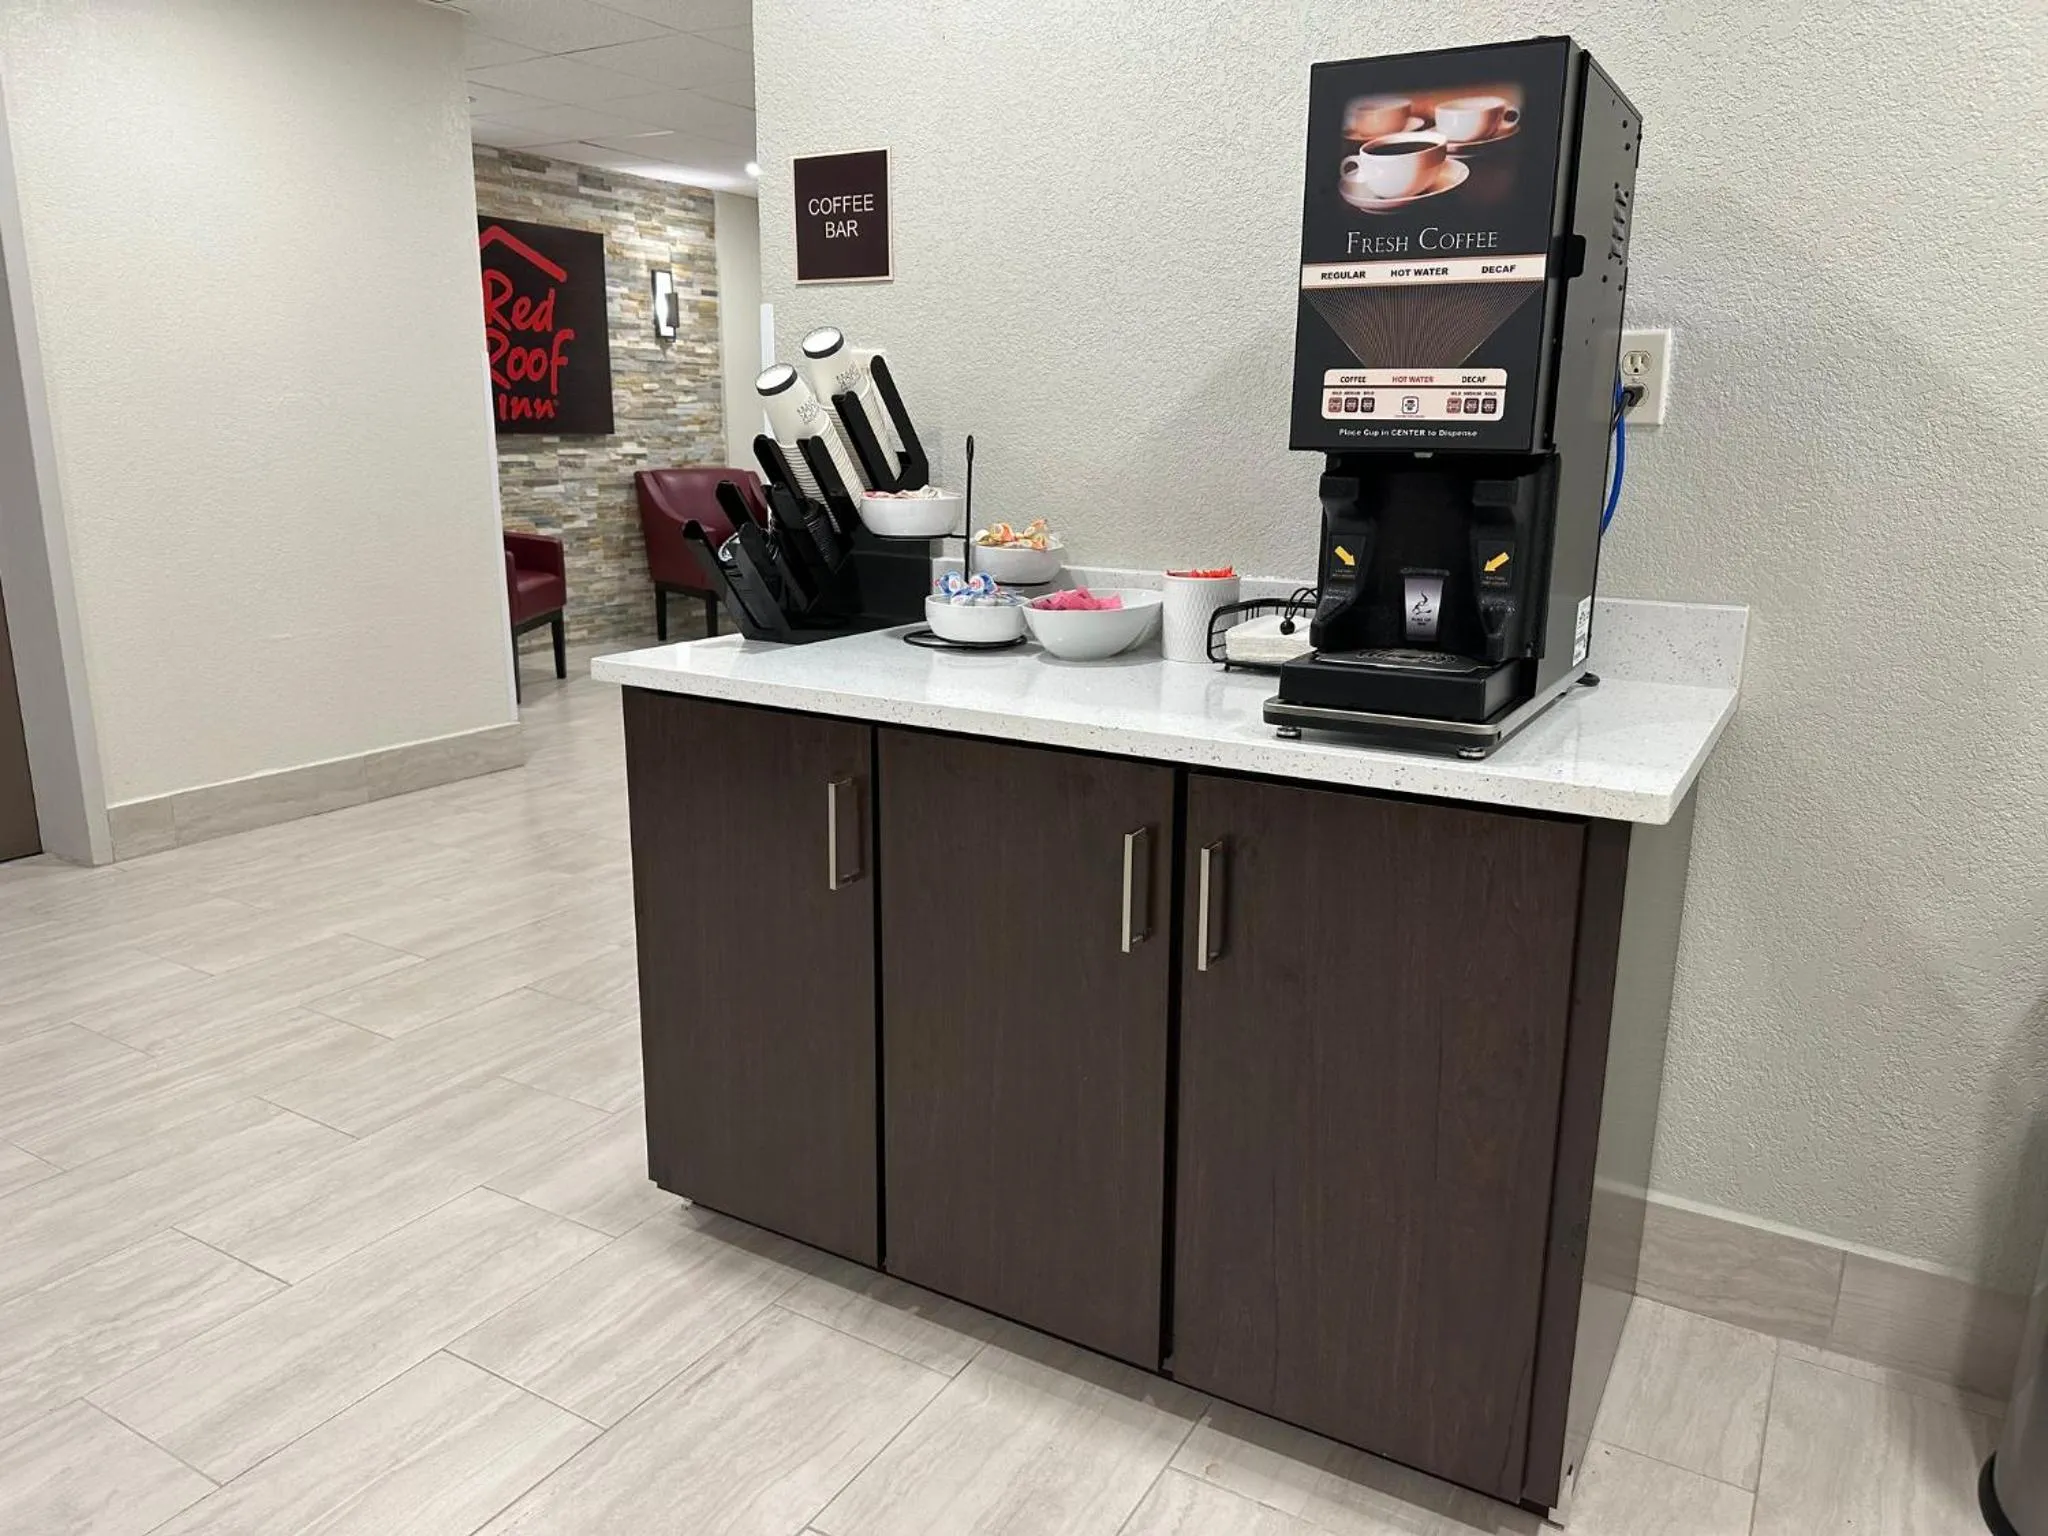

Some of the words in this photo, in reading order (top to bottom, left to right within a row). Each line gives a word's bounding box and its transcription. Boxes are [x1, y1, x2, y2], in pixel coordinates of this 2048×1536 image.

[808, 194, 874, 215] COFFEE
[825, 220, 859, 238] BAR
[1320, 271, 1366, 280] REGULAR
[1390, 269, 1411, 277] HOT
[1414, 267, 1448, 276] WATER
[1481, 265, 1516, 274] DECAF
[482, 268, 556, 332] Red
[486, 327, 575, 395] Roof
[1338, 428, 1362, 436] Place
[1363, 428, 1380, 437] Cup
[1381, 428, 1389, 436] in
[1390, 429, 1426, 437] CENTER
[1427, 429, 1437, 437] to
[1438, 429, 1478, 438] Dispense
